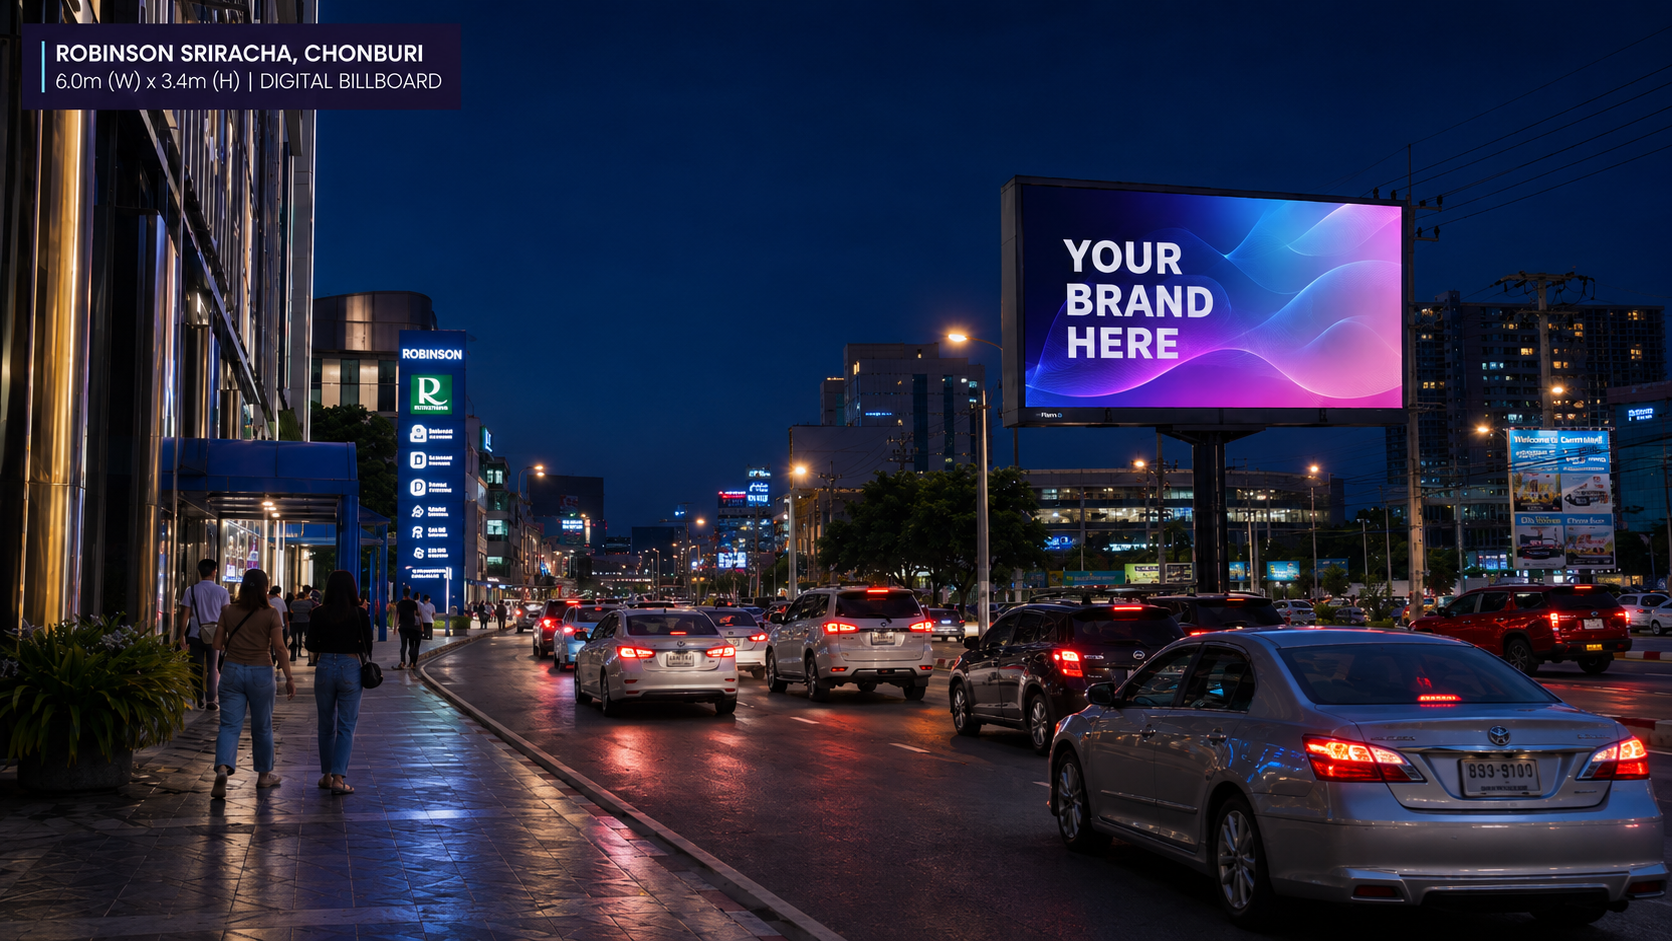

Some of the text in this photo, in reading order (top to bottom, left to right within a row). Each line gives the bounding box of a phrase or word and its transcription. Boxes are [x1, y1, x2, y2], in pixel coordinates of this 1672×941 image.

[1063, 238, 1183, 275] YOUR
[1066, 283, 1214, 318] BRAND
[402, 348, 463, 361] ROBINSON
[1067, 326, 1179, 360] HERE
[417, 377, 448, 406] R
